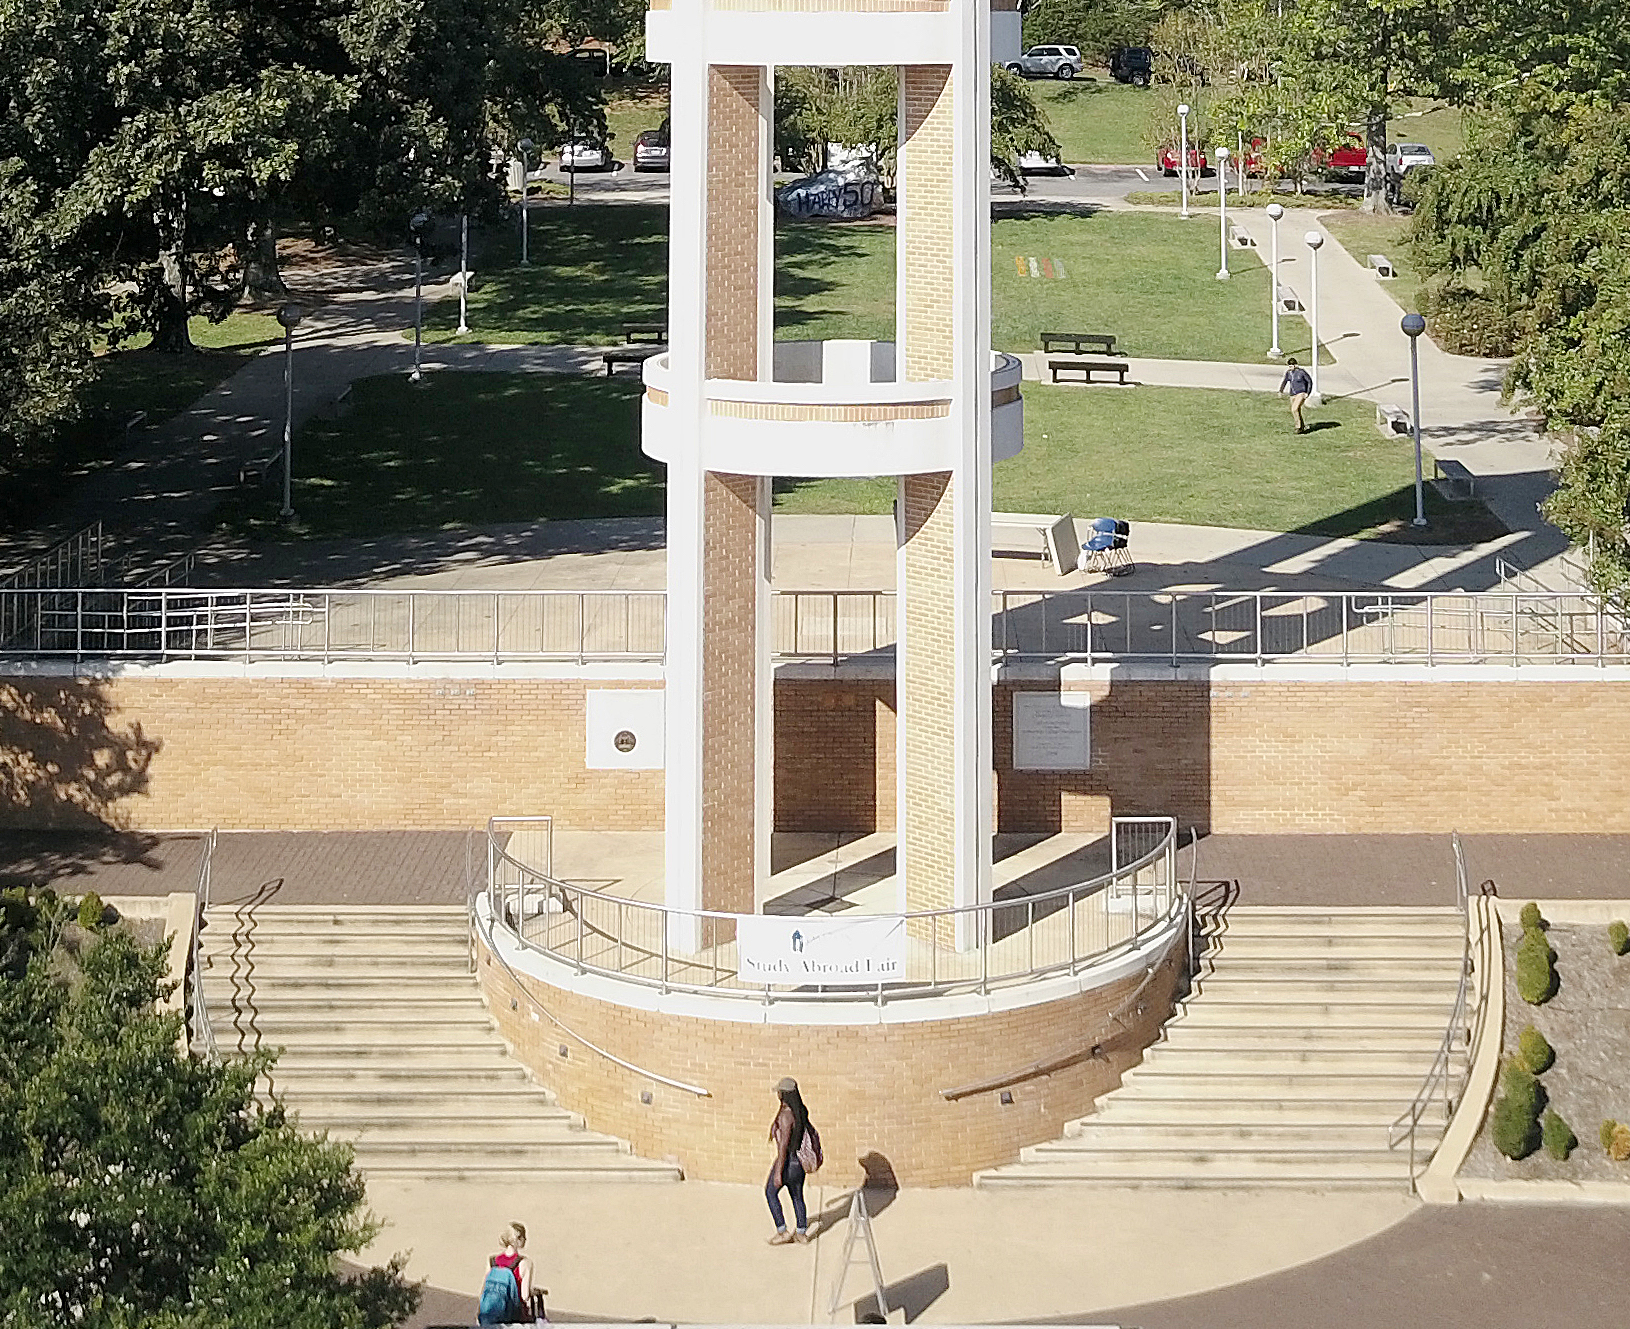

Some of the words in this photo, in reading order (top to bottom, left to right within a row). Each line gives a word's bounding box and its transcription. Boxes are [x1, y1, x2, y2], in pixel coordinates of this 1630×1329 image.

[842, 181, 874, 211] 50
[746, 957, 790, 973] Study
[802, 959, 859, 973] Abroad
[866, 957, 898, 972] Fair
